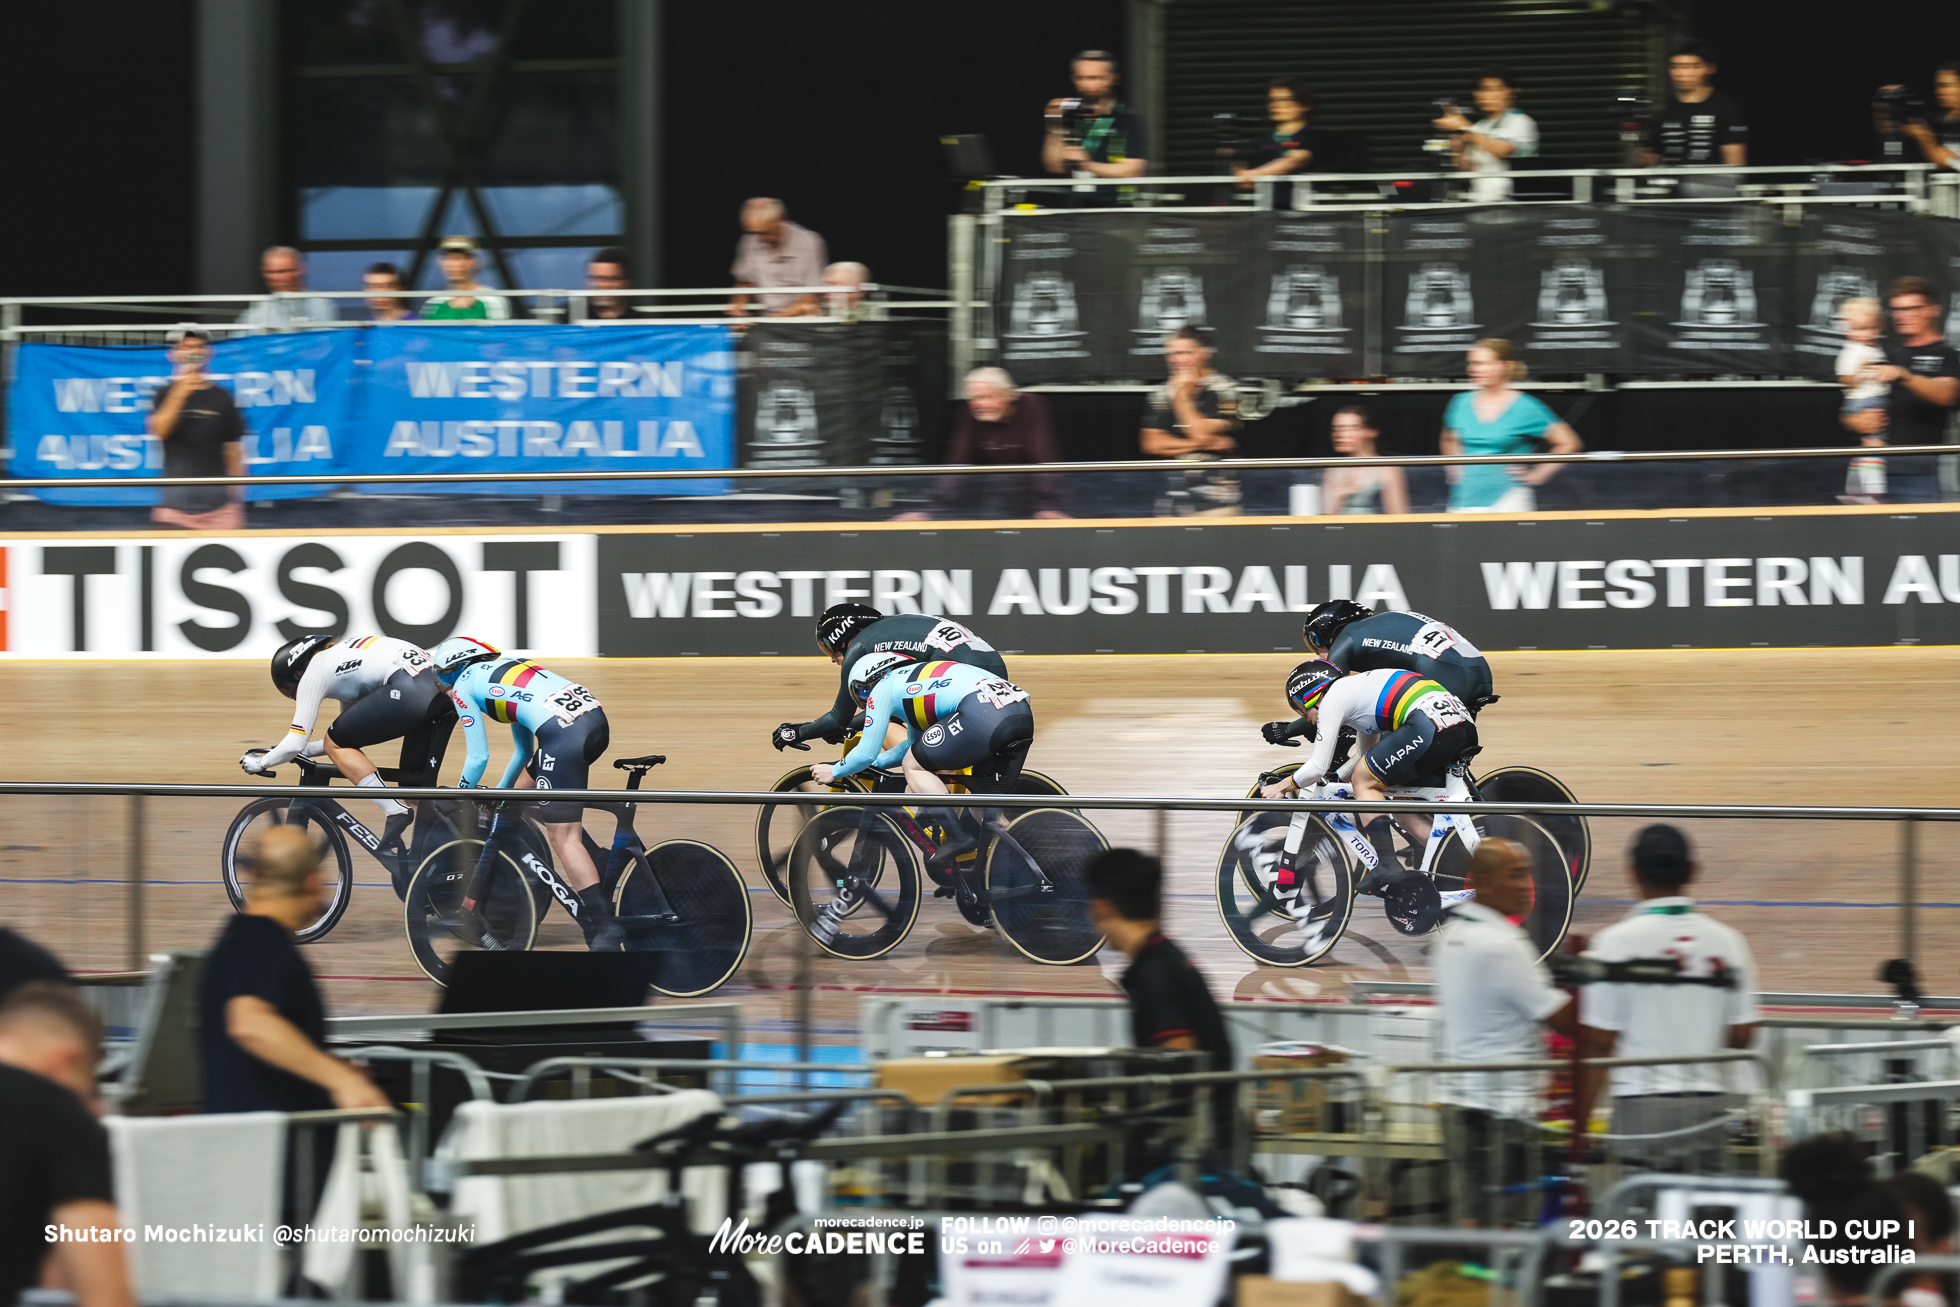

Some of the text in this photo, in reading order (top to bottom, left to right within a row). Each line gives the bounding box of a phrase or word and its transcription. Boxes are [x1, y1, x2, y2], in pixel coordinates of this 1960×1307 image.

[53, 368, 317, 414] WESRN
[405, 360, 684, 399] WESTERN
[36, 424, 333, 471] AUSTLIA
[383, 420, 706, 458] AUSTRALIA
[41, 541, 562, 653] TISSOT
[620, 563, 1411, 619] WESTERN AUSTRALIA
[1480, 555, 1865, 610] WESTERN
[828, 615, 855, 644] KASK
[937, 626, 962, 641] 40
[1361, 637, 1382, 648] NEW
[402, 649, 427, 666] 33
[874, 640, 928, 653] NEW ZEALAND
[334, 659, 363, 674] KTM
[864, 656, 897, 677] LAZER
[510, 690, 535, 703] AG
[928, 678, 953, 691] AG
[1288, 669, 1329, 698] Kabuto
[554, 692, 582, 711] 28
[947, 718, 964, 736] EY
[542, 753, 556, 771] EY
[1385, 735, 1424, 769] JAPAN
[336, 811, 381, 851] FES
[521, 852, 579, 917] KOGA
